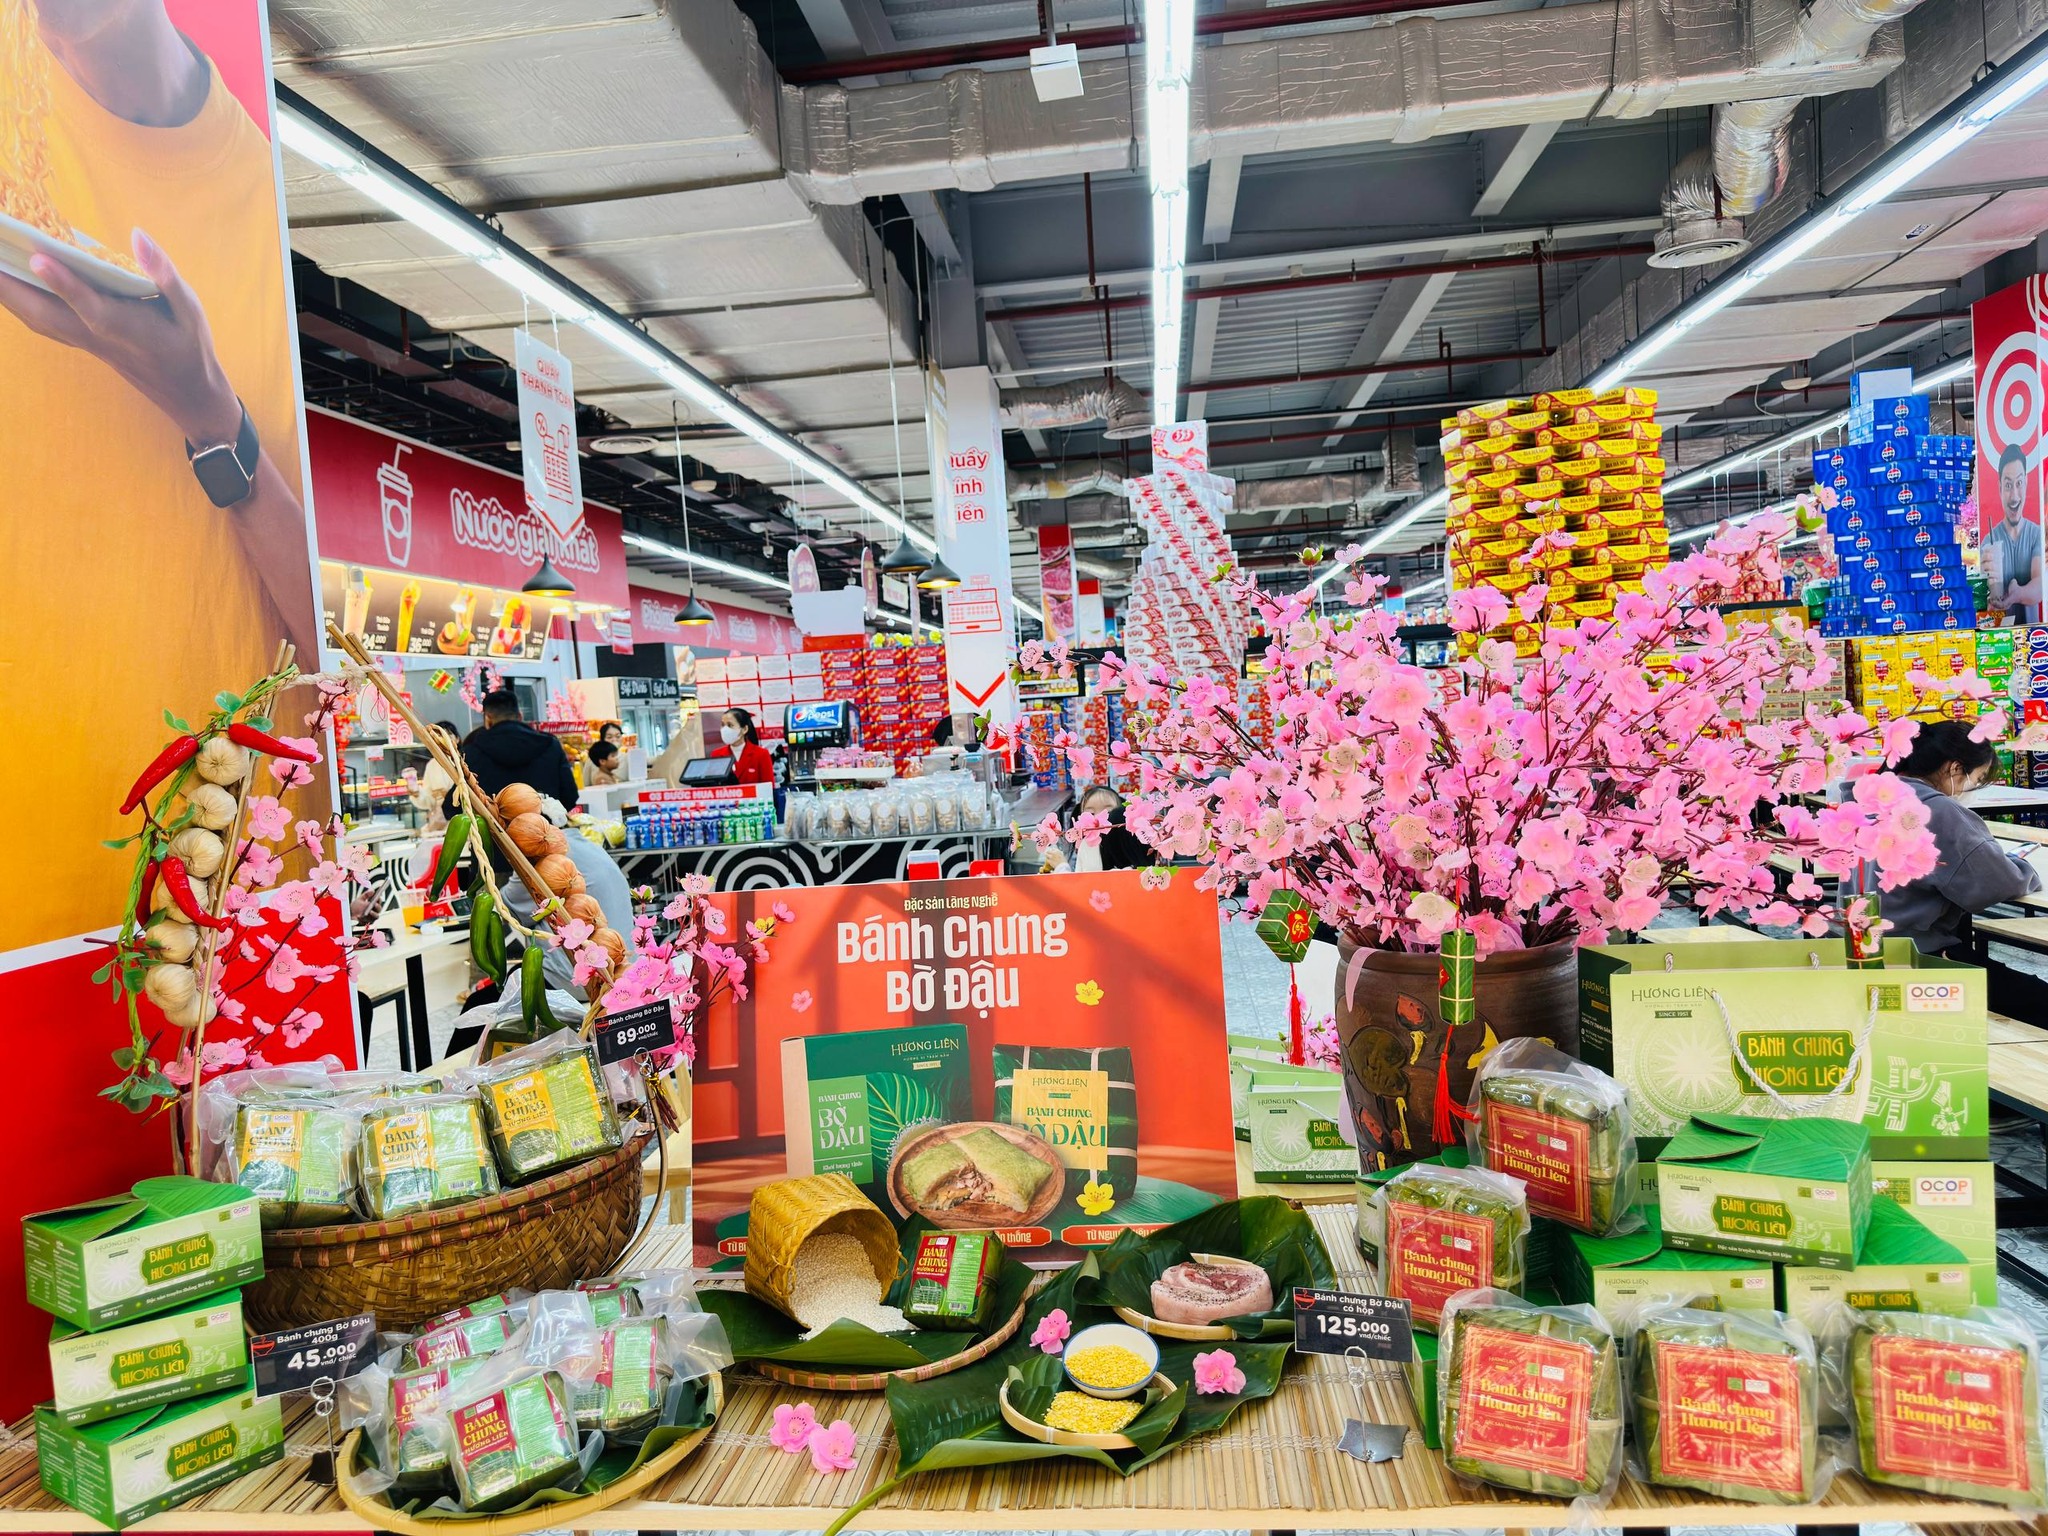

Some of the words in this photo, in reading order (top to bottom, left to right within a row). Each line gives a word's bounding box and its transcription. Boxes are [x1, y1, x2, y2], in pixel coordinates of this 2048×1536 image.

[954, 478, 982, 494] ính
[956, 503, 984, 521] iền
[453, 494, 517, 553] Nước
[904, 897, 924, 913] Đặc
[925, 896, 944, 910] Sản
[971, 892, 998, 908] Nghề
[837, 914, 934, 964] Bánh
[944, 912, 1068, 958] Chưng
[886, 964, 936, 1013] Bờ
[944, 959, 1020, 1018] Đậu
[1632, 988, 1680, 1002] HƯƠNG
[1684, 986, 1714, 1000] LIÊN
[1912, 986, 1960, 998] OCOP
[608, 1016, 624, 1026] Bánh
[624, 1011, 643, 1020] chưng
[616, 1022, 656, 1045] 89.000
[892, 1040, 932, 1057] HƯƠNG
[934, 1038, 960, 1050] LIÊN
[1748, 1035, 1786, 1057] BÁNH
[1792, 1036, 1844, 1056] CHƯNG
[1032, 1077, 1065, 1088] HƯƠNG
[1066, 1077, 1088, 1088] LIÊN
[818, 1102, 847, 1129] BỜ
[1026, 1106, 1054, 1117] BÁNH
[1056, 1107, 1092, 1118] CHƯNG
[1052, 1121, 1106, 1150] ĐẬU
[1314, 1121, 1332, 1132] BÁNH
[820, 1124, 864, 1151] ĐẬU
[1921, 1180, 1968, 1192] OCOP
[1722, 1198, 1746, 1212] BÁNH
[1750, 1202, 1784, 1218] CHƯNG
[1007, 1228, 1032, 1244] thống
[1764, 1221, 1786, 1236] LIÊN
[150, 1248, 173, 1264] BÁNH
[176, 1236, 206, 1254] CHƯNG
[190, 1252, 210, 1270] LIÊN
[1314, 1292, 1338, 1302] Bánh
[1340, 1296, 1367, 1306] chưng
[1370, 1298, 1382, 1306] Bờ
[1384, 1301, 1403, 1310] Đậu
[1851, 1294, 1876, 1307] BÁNH
[1878, 1292, 1911, 1306] CHƯNG
[1343, 1304, 1354, 1312] có
[1356, 1305, 1374, 1316] hộp
[277, 1332, 302, 1344] Bánh
[304, 1326, 334, 1339] chưng
[336, 1323, 350, 1332] Bờ
[352, 1317, 370, 1328] Đậu
[1316, 1314, 1390, 1336] 125.000
[312, 1334, 338, 1344] 400g
[119, 1352, 144, 1368] BÁNH
[148, 1342, 181, 1360] CHƯNG
[288, 1342, 356, 1370] 45.000
[163, 1358, 185, 1375] LIÊN
[464, 1410, 498, 1434] BÁNH
[464, 1420, 506, 1446] CHƯNG
[174, 1441, 198, 1460] BÁNH
[200, 1426, 230, 1447] CHƯNG
[214, 1444, 232, 1461] LIÊN
